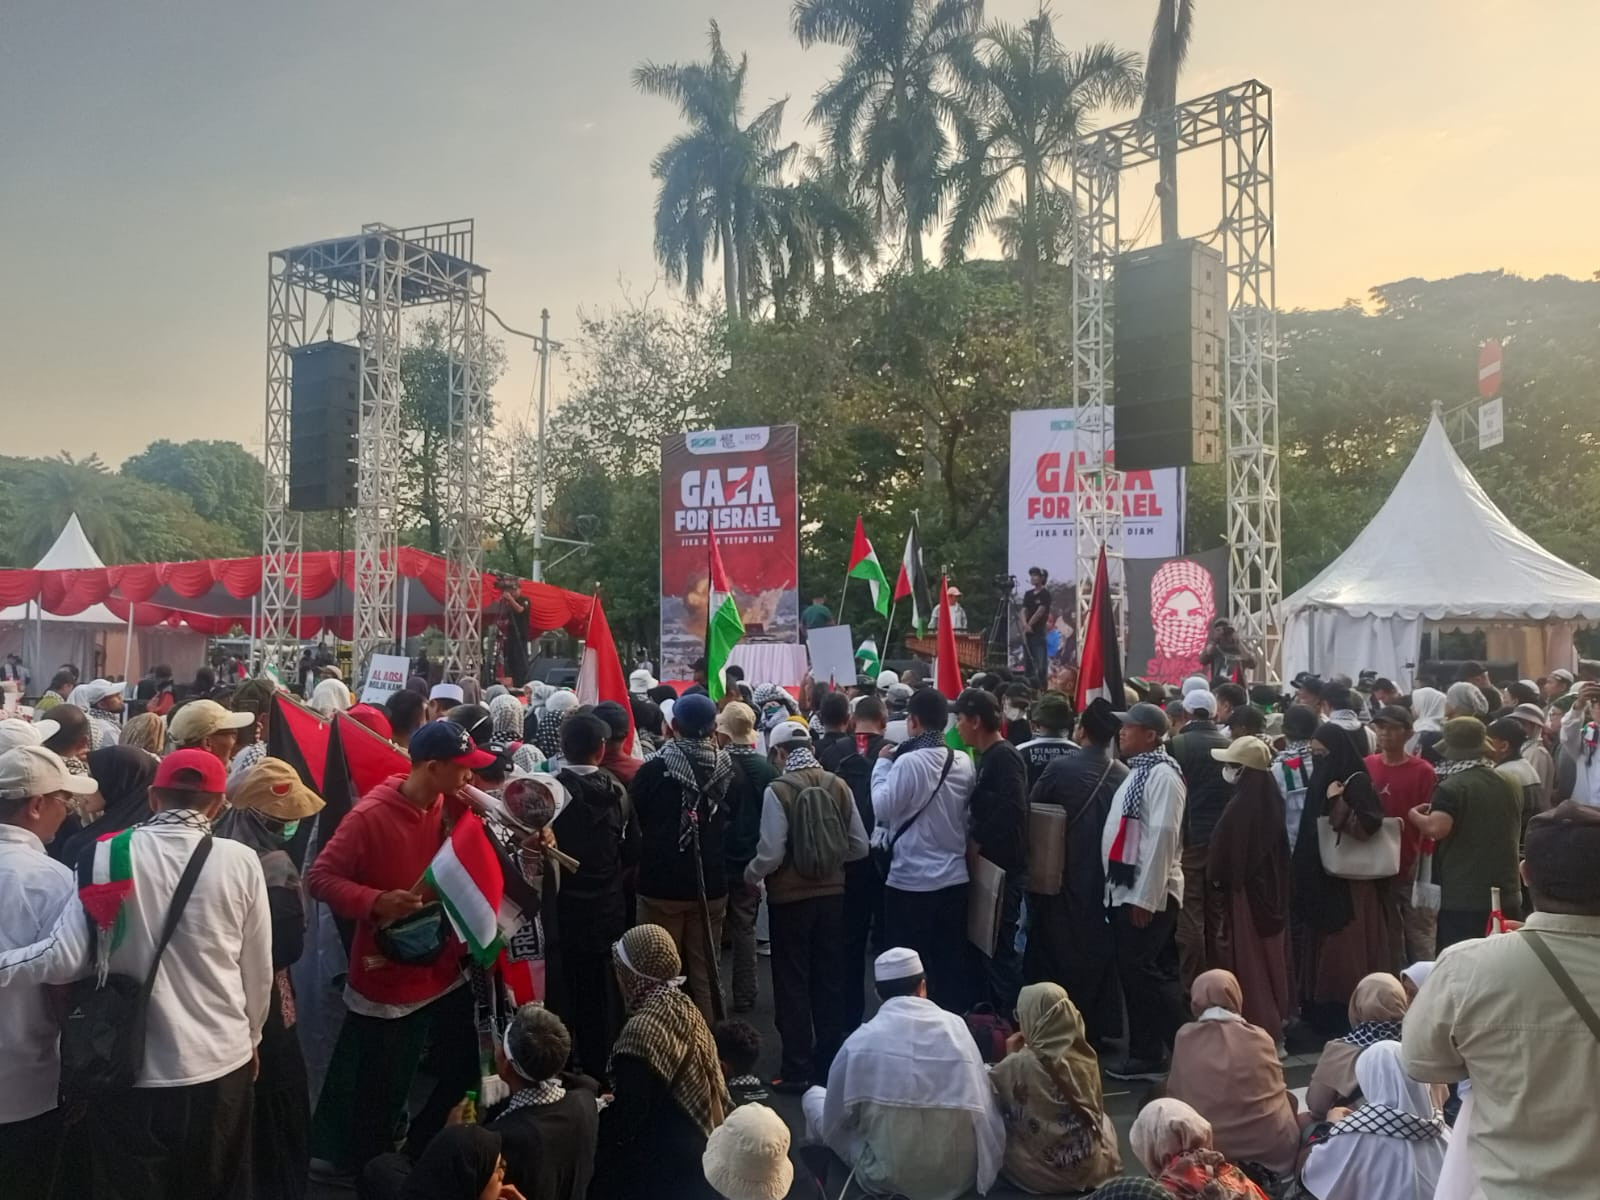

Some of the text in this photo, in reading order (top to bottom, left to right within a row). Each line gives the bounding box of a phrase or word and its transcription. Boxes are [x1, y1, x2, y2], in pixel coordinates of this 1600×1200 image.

[681, 465, 774, 507] GAZA
[1027, 494, 1163, 520] FOR AEL
[674, 505, 781, 532] FOR ISRAEL
[1035, 528, 1057, 537] JIKA
[1063, 528, 1085, 537] KIA
[1127, 527, 1154, 536] DIAM
[681, 538, 699, 547] JIKA
[703, 537, 721, 546] KA
[372, 670, 382, 680] AL
